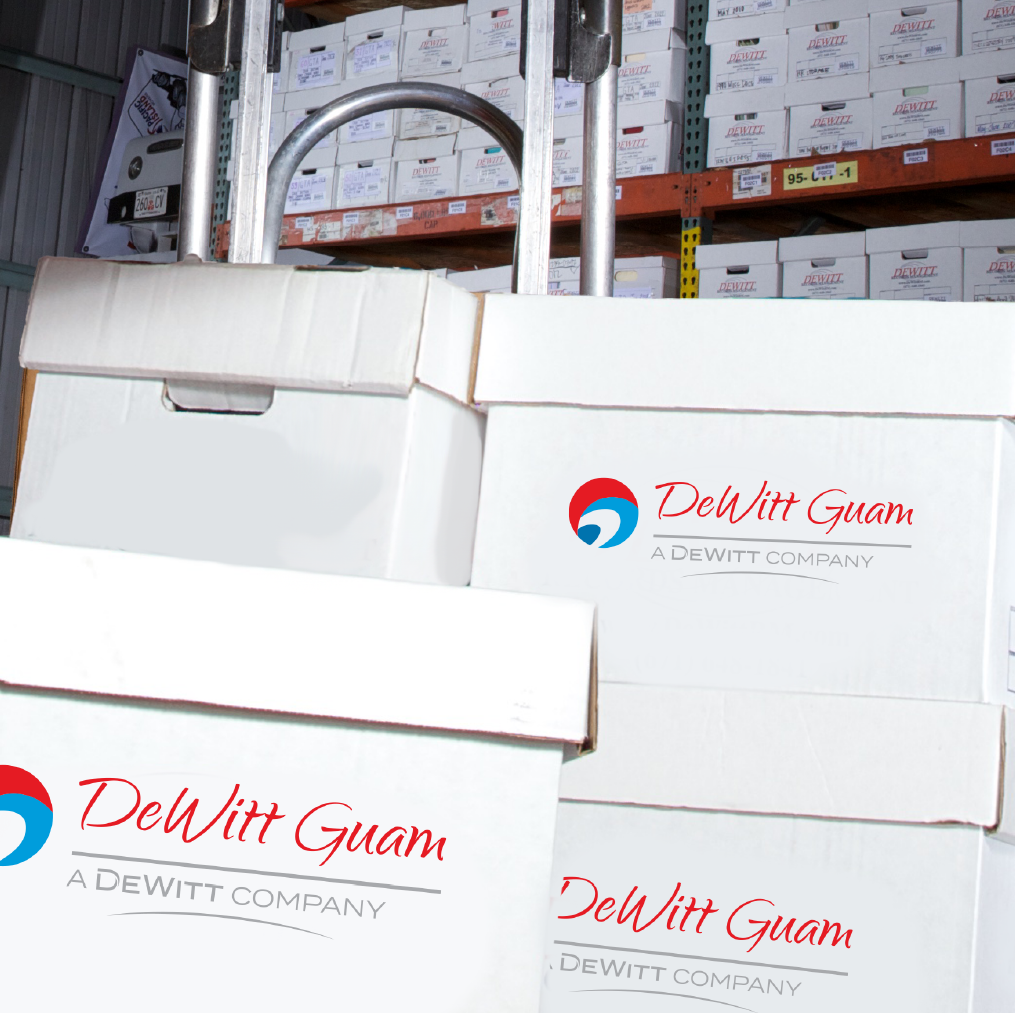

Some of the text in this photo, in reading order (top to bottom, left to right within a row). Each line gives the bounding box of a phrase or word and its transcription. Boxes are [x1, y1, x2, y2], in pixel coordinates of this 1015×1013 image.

[717, 8, 729, 17] MAY
[891, 19, 935, 35] DEWITT
[807, 34, 847, 50] DEWITT
[727, 50, 767, 65] DEWITT
[134, 100, 153, 127] PACIFIC
[894, 100, 937, 115] DEWITT
[813, 114, 853, 128] DEWITT
[726, 124, 765, 138] DEWITT
[135, 196, 148, 212] 260
[424, 220, 438, 230] CAP
[803, 272, 843, 285] DEWITT
[892, 266, 937, 280] DEWITT
[719, 281, 757, 293] DEWITT
[655, 481, 914, 534] DeWitt Guam
[651, 546, 666, 560] A
[766, 551, 874, 569] COMPANY
[79, 778, 447, 867] DeWitt Guam
[66, 869, 87, 889] A
[231, 886, 386, 919] COMPANY
[558, 876, 854, 953] DeWitt Guam
[673, 968, 802, 997] COMPANY
